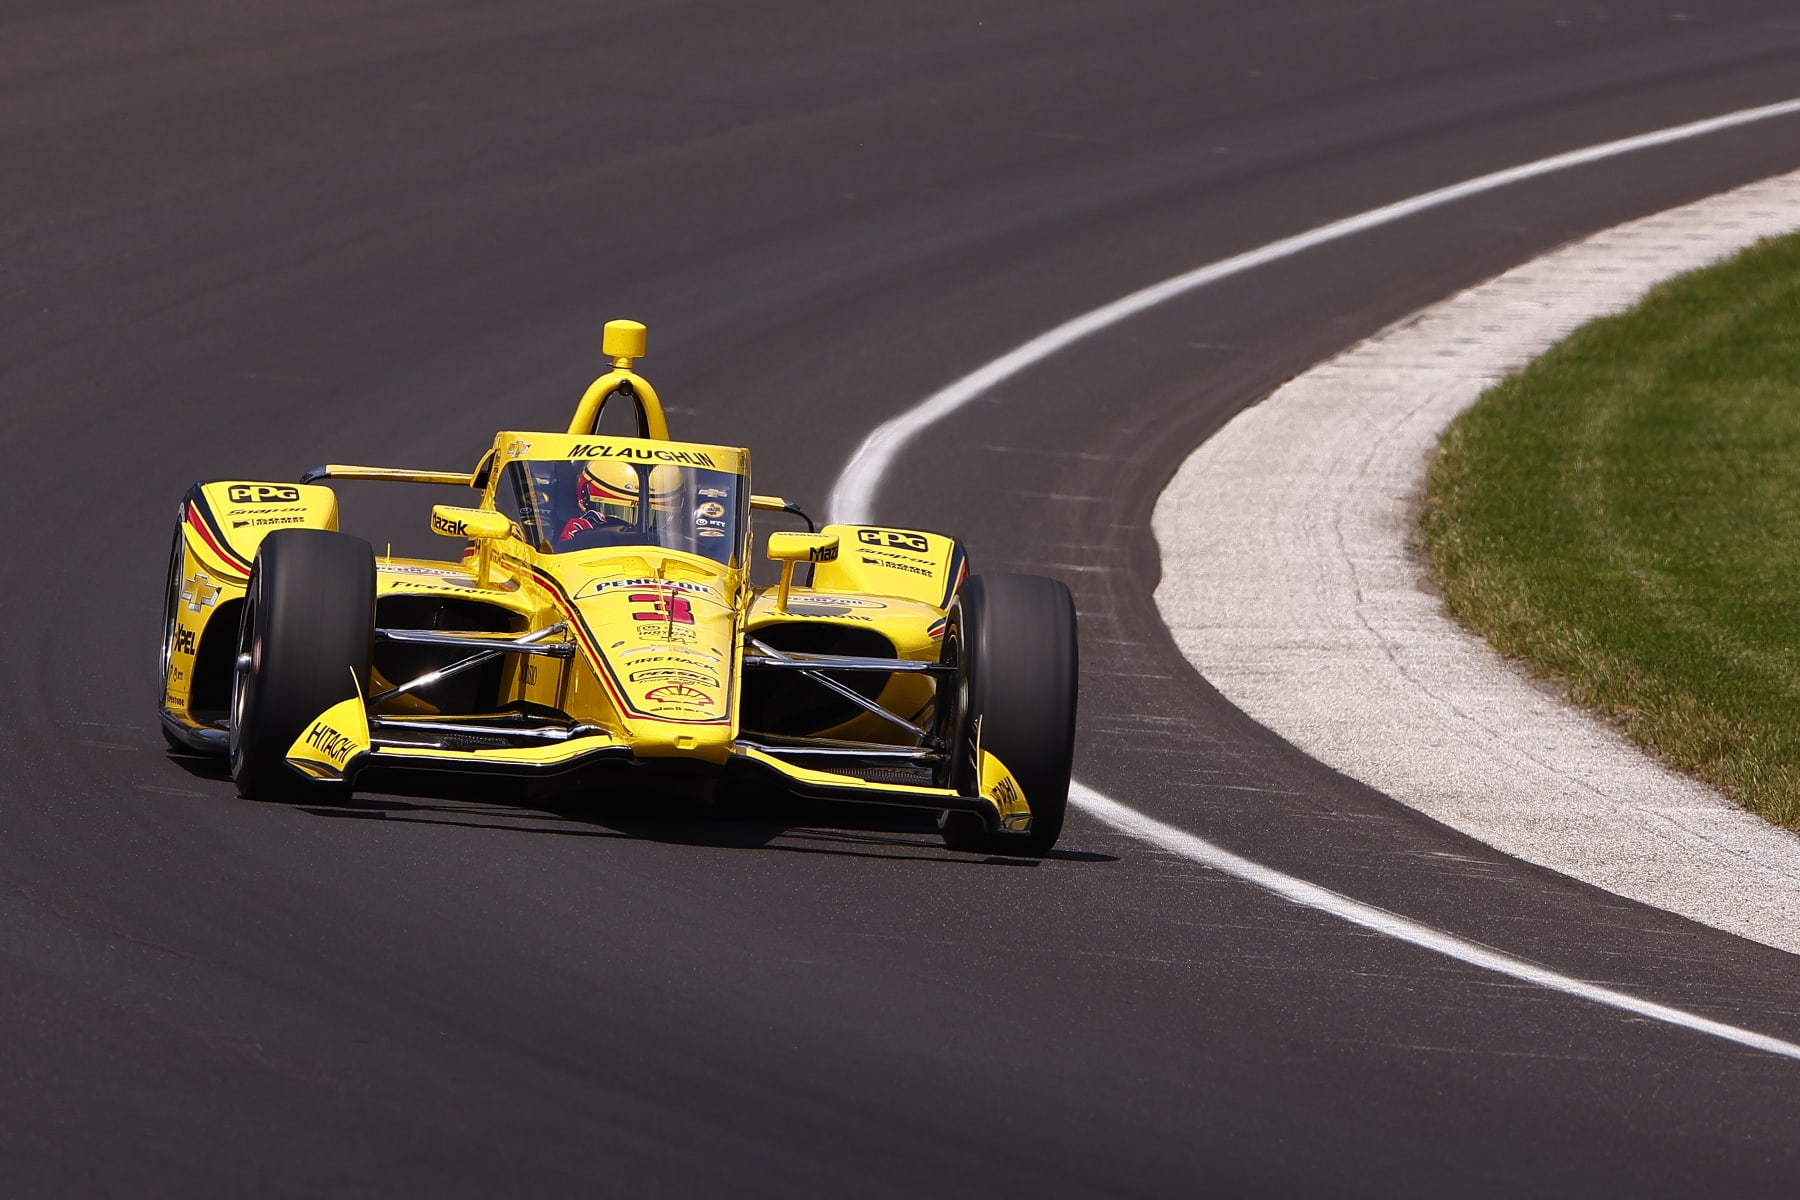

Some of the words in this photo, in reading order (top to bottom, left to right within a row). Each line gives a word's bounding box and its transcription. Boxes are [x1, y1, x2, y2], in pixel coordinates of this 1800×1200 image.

[567, 444, 716, 468] MCLAUGHLIN
[229, 485, 299, 502] PPG
[860, 531, 928, 551] PPG
[391, 581, 508, 596] Firestone
[595, 578, 716, 597] PENNZOIL
[628, 593, 696, 625] 3
[173, 623, 196, 656] XPEL
[624, 656, 665, 667] TIRE
[667, 656, 721, 675] RACK
[305, 721, 359, 764] HITACHI
